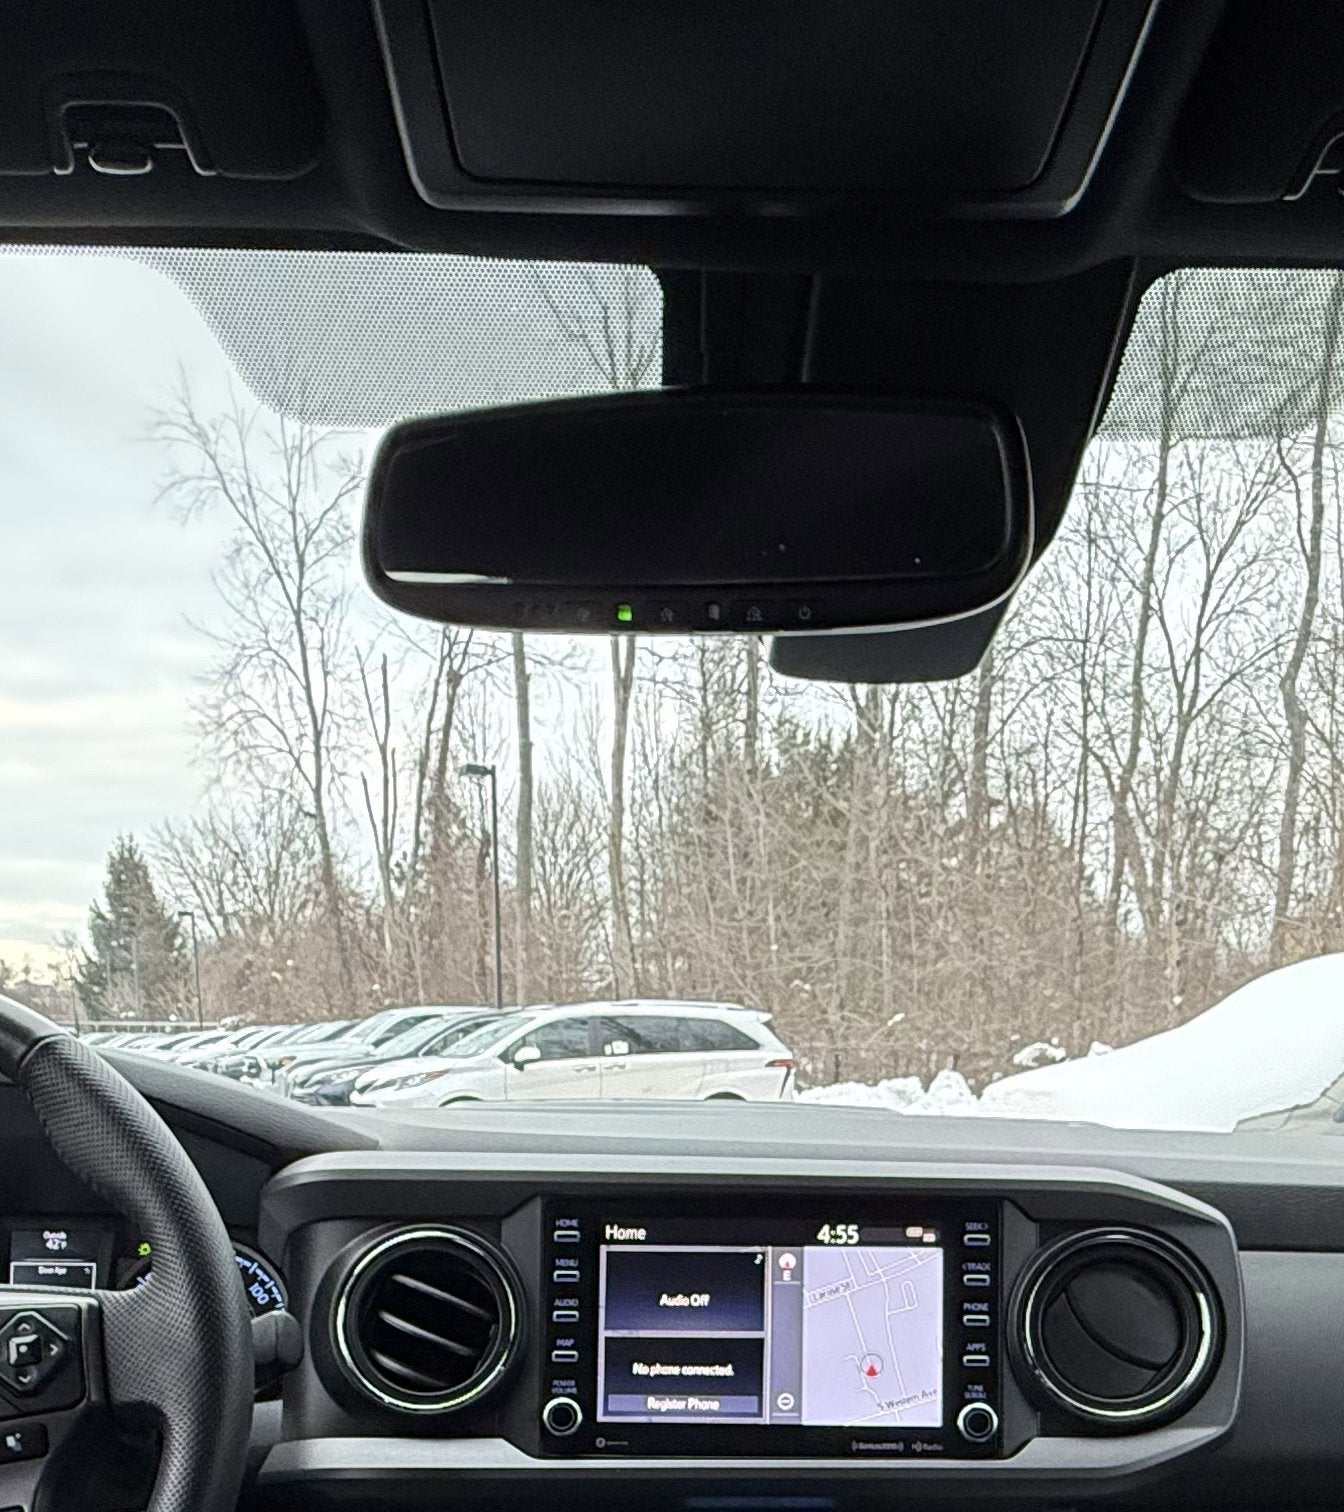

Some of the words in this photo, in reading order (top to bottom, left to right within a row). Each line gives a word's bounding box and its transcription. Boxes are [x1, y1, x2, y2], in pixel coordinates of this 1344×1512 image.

[556, 1219, 579, 1227] HOME
[605, 1224, 646, 1241] Home
[816, 1224, 860, 1244] 4:55
[555, 1258, 578, 1267] MENU
[248, 1282, 270, 1305] 100
[659, 1293, 690, 1307] Audio
[690, 1293, 711, 1307] Off
[554, 1298, 579, 1307] AUDIO
[963, 1303, 989, 1311] PHONE
[556, 1338, 574, 1347] MAP
[966, 1343, 986, 1352] APPS
[632, 1362, 649, 1375] No
[649, 1363, 681, 1377] phone
[647, 1397, 687, 1412] Register
[687, 1397, 720, 1411] Phone
[884, 1393, 920, 1409] Western
